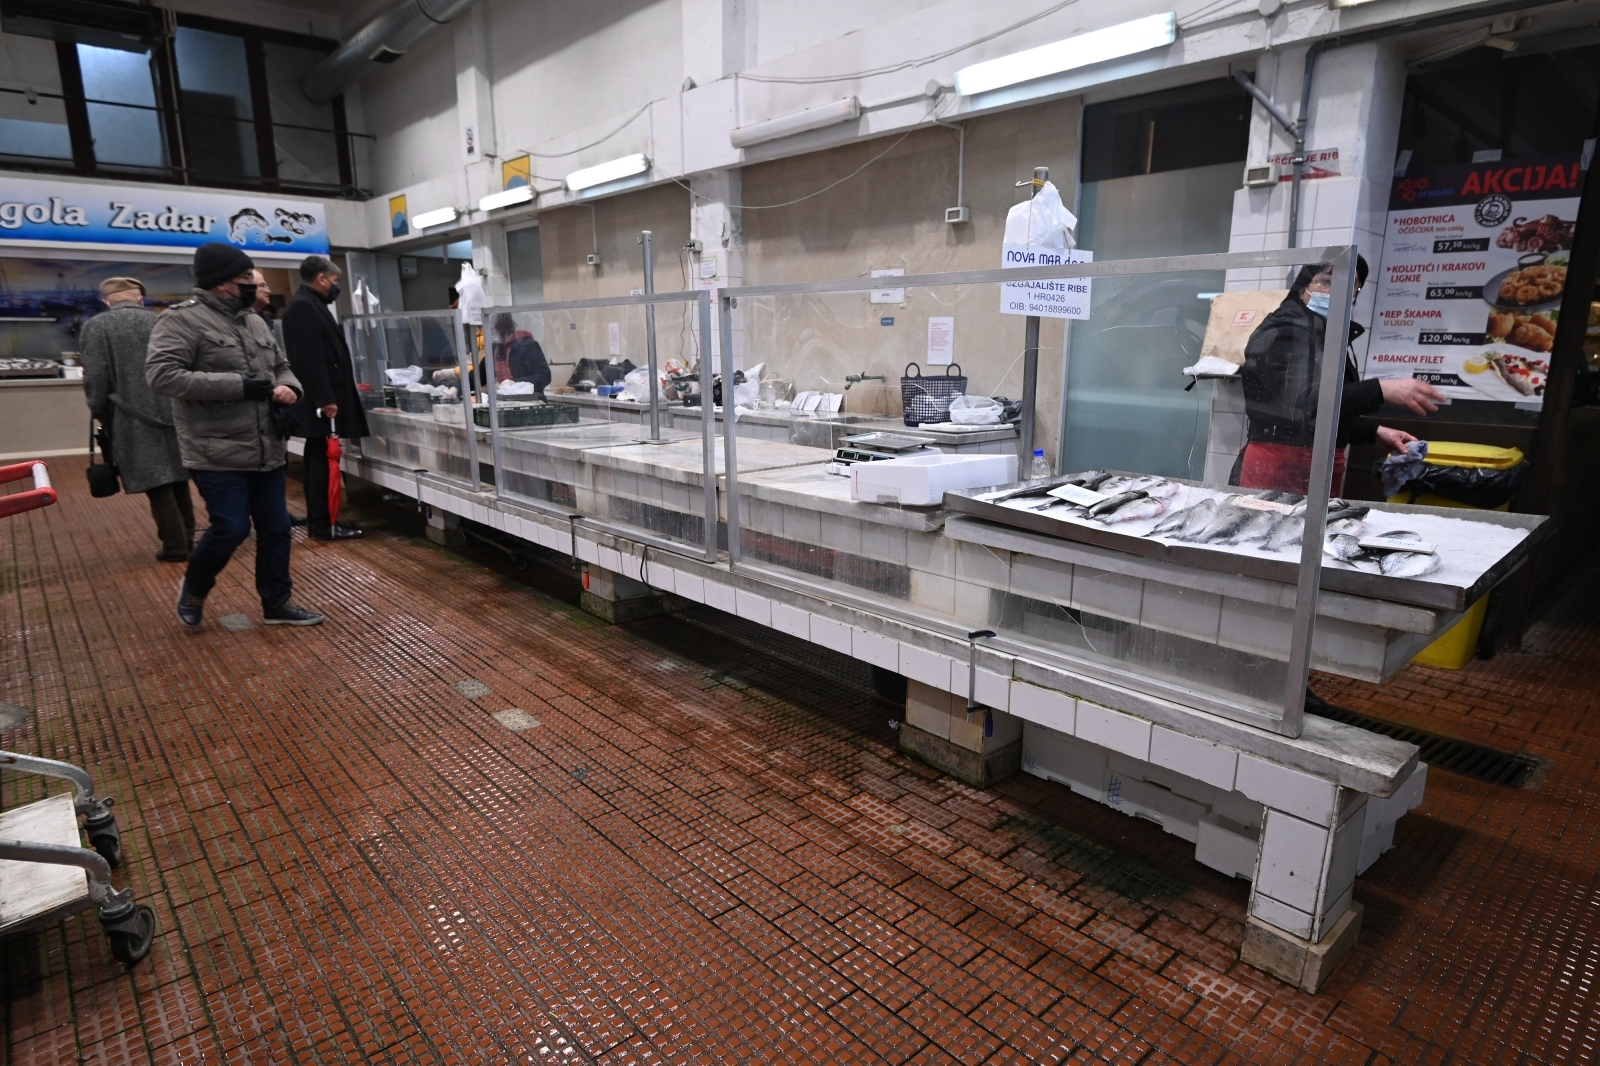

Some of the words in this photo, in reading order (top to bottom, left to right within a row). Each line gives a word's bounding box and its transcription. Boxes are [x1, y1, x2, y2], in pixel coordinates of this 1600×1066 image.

[1460, 163, 1580, 196] AKCIJA!
[0, 197, 89, 228] gola
[109, 202, 218, 233] Zadar
[1399, 214, 1455, 226] HOBOTNICA
[1398, 226, 1434, 234] OČIŠĆENA
[1437, 241, 1462, 251] 57,50
[1007, 250, 1035, 264] NOVA
[1039, 254, 1060, 265] MAR
[1392, 262, 1434, 273] KOLUTIĆI
[1442, 262, 1485, 271] KRAKOVI
[1390, 274, 1422, 283] LIGNJE
[1068, 284, 1088, 293] RIBE
[1430, 288, 1454, 297] 63,00
[1034, 293, 1065, 302] HR0426
[1010, 302, 1026, 310] OIB:
[1029, 304, 1081, 315] 94018899600
[1404, 309, 1442, 318] ŠKAMPA
[1422, 334, 1452, 343] 120,00
[1377, 354, 1418, 363] BRANCIN
[1420, 355, 1445, 364] FILET
